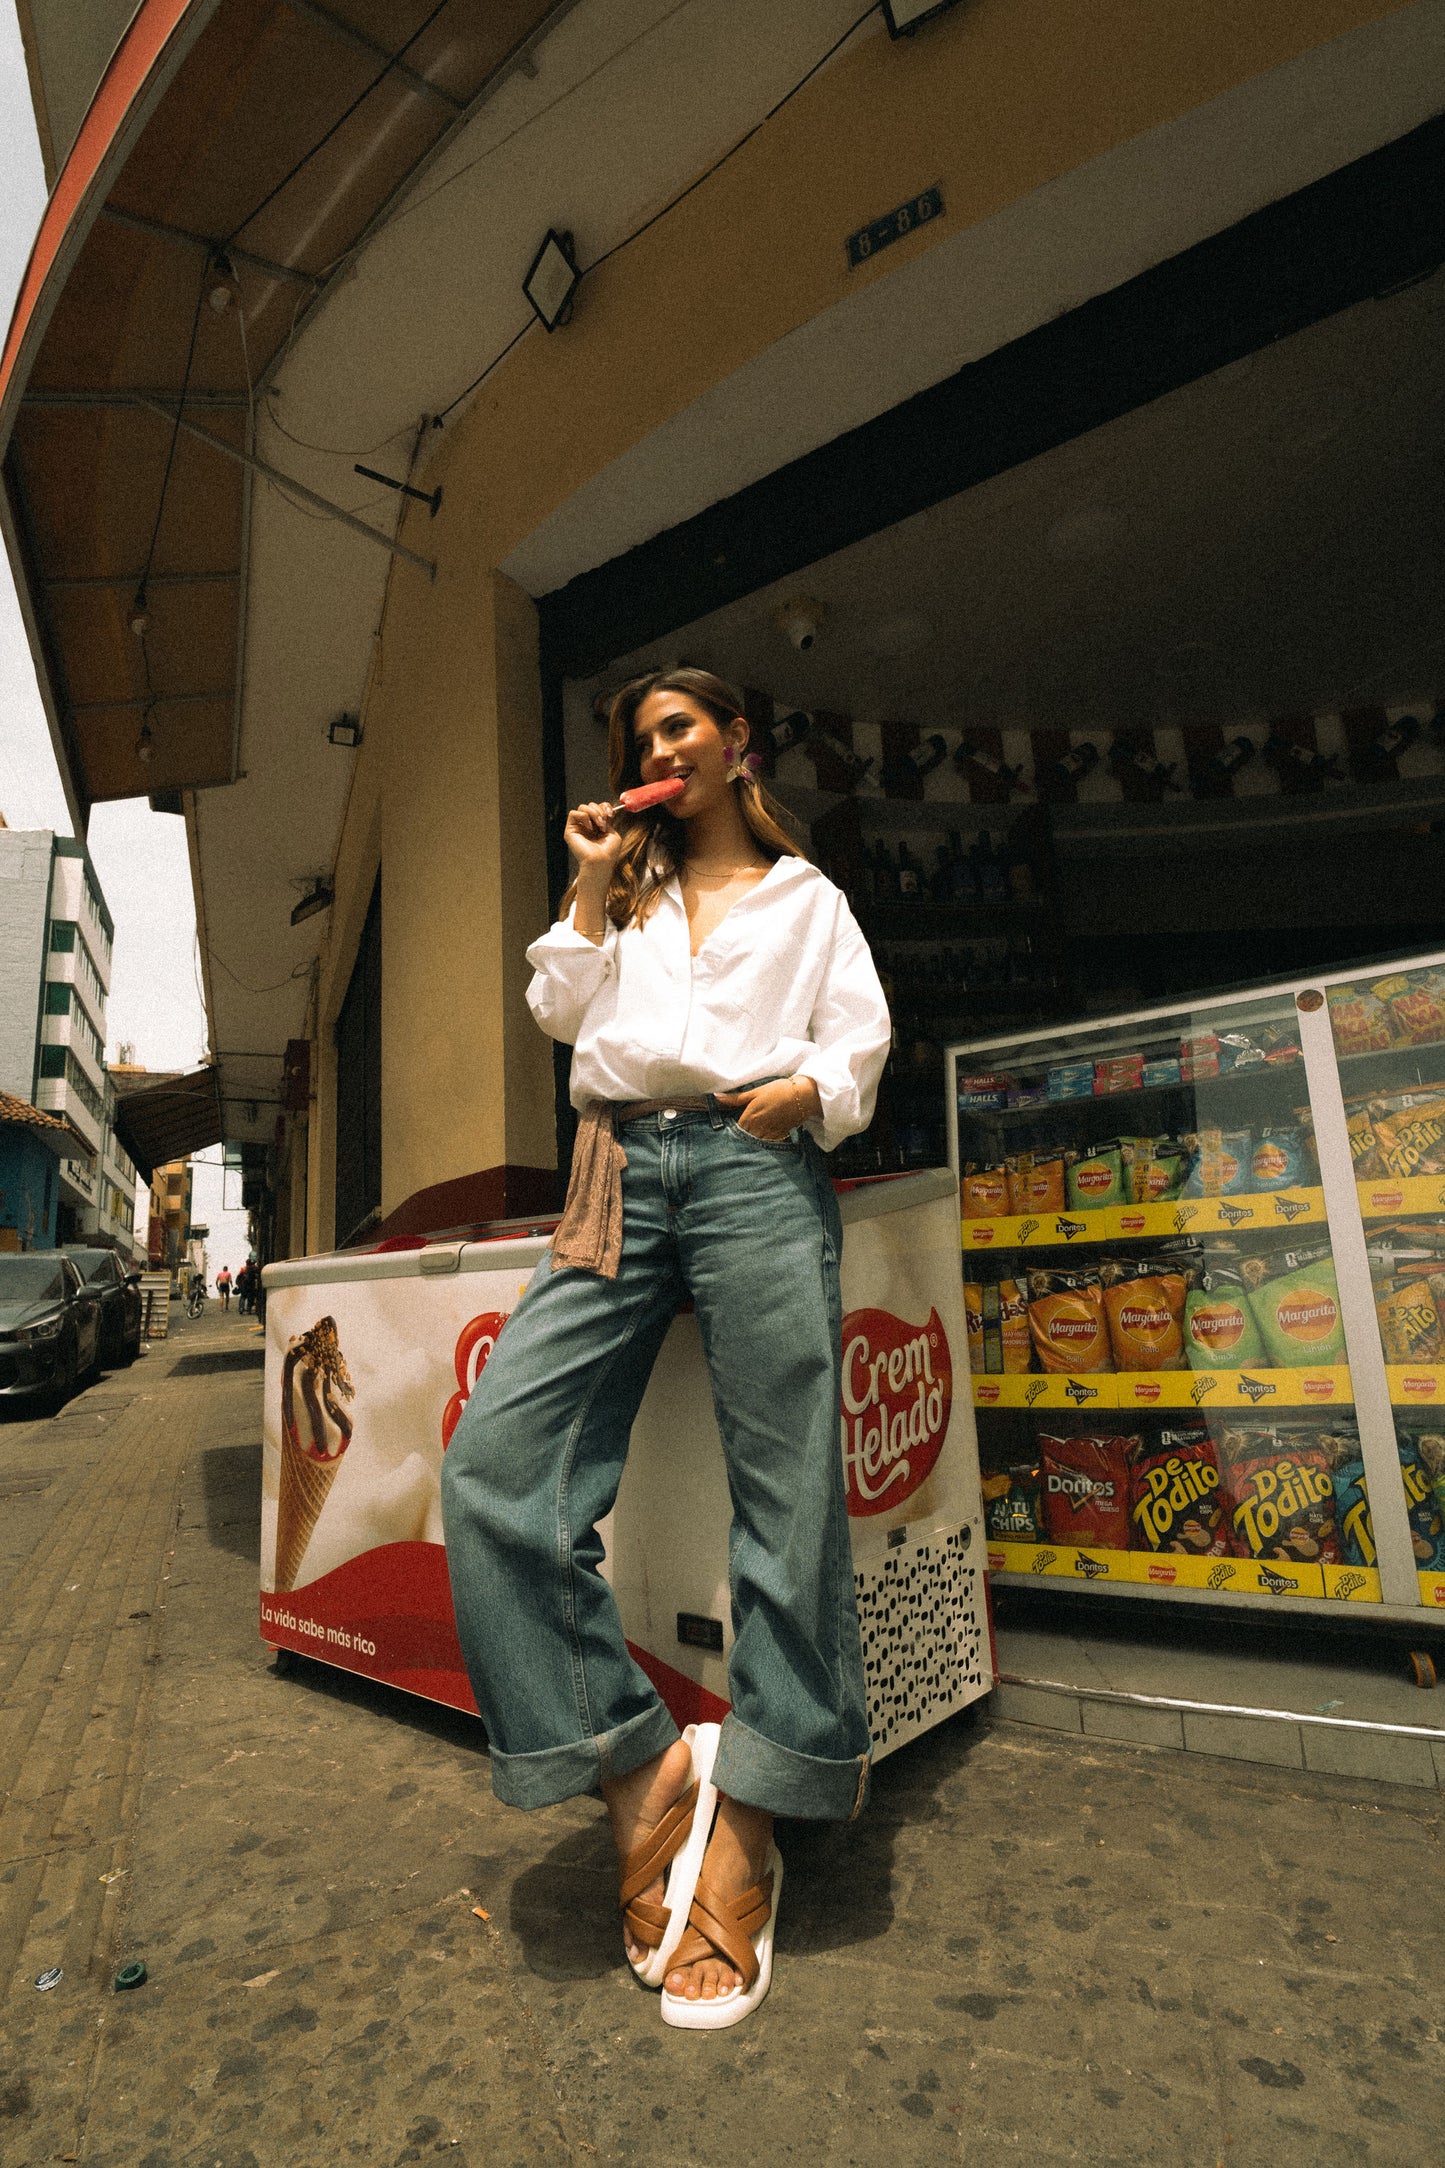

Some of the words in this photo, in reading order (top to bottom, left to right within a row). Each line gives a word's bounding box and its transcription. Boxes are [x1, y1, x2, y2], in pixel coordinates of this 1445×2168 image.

[970, 1095, 998, 1103] HALLS
[1398, 1121, 1422, 1146] De
[1077, 1174, 1113, 1185] Margarita
[1220, 1210, 1253, 1218] Doritos
[1276, 1203, 1310, 1213] Doritos
[1058, 1224, 1086, 1232] Doritos
[1121, 1311, 1171, 1326] Margarita
[1278, 1305, 1337, 1324] Margarita
[1049, 1322, 1098, 1336] Margarita
[1191, 1316, 1244, 1332] Margarita
[1303, 1343, 1332, 1353] Limón
[842, 1333, 935, 1415] Crem
[1068, 1388, 1097, 1397] Doritos
[1241, 1384, 1275, 1393] Doritos
[841, 1378, 944, 1500] Helado
[1144, 1457, 1183, 1498] De
[1251, 1461, 1295, 1500] De
[1047, 1475, 1115, 1497] Doritos
[995, 1502, 1029, 1517] NATU
[1133, 1460, 1219, 1551] Todito
[1233, 1465, 1333, 1558] Todito
[991, 1518, 1035, 1531] CHIPS
[1077, 1562, 1108, 1573] Doritos
[1208, 1564, 1236, 1590] Todito
[1261, 1576, 1298, 1589] Doritos
[1334, 1573, 1367, 1600] Todito
[261, 1602, 272, 1622] La
[274, 1608, 297, 1631] vida
[299, 1617, 325, 1640] sabe
[327, 1626, 351, 1648] más
[353, 1632, 376, 1656] rico
